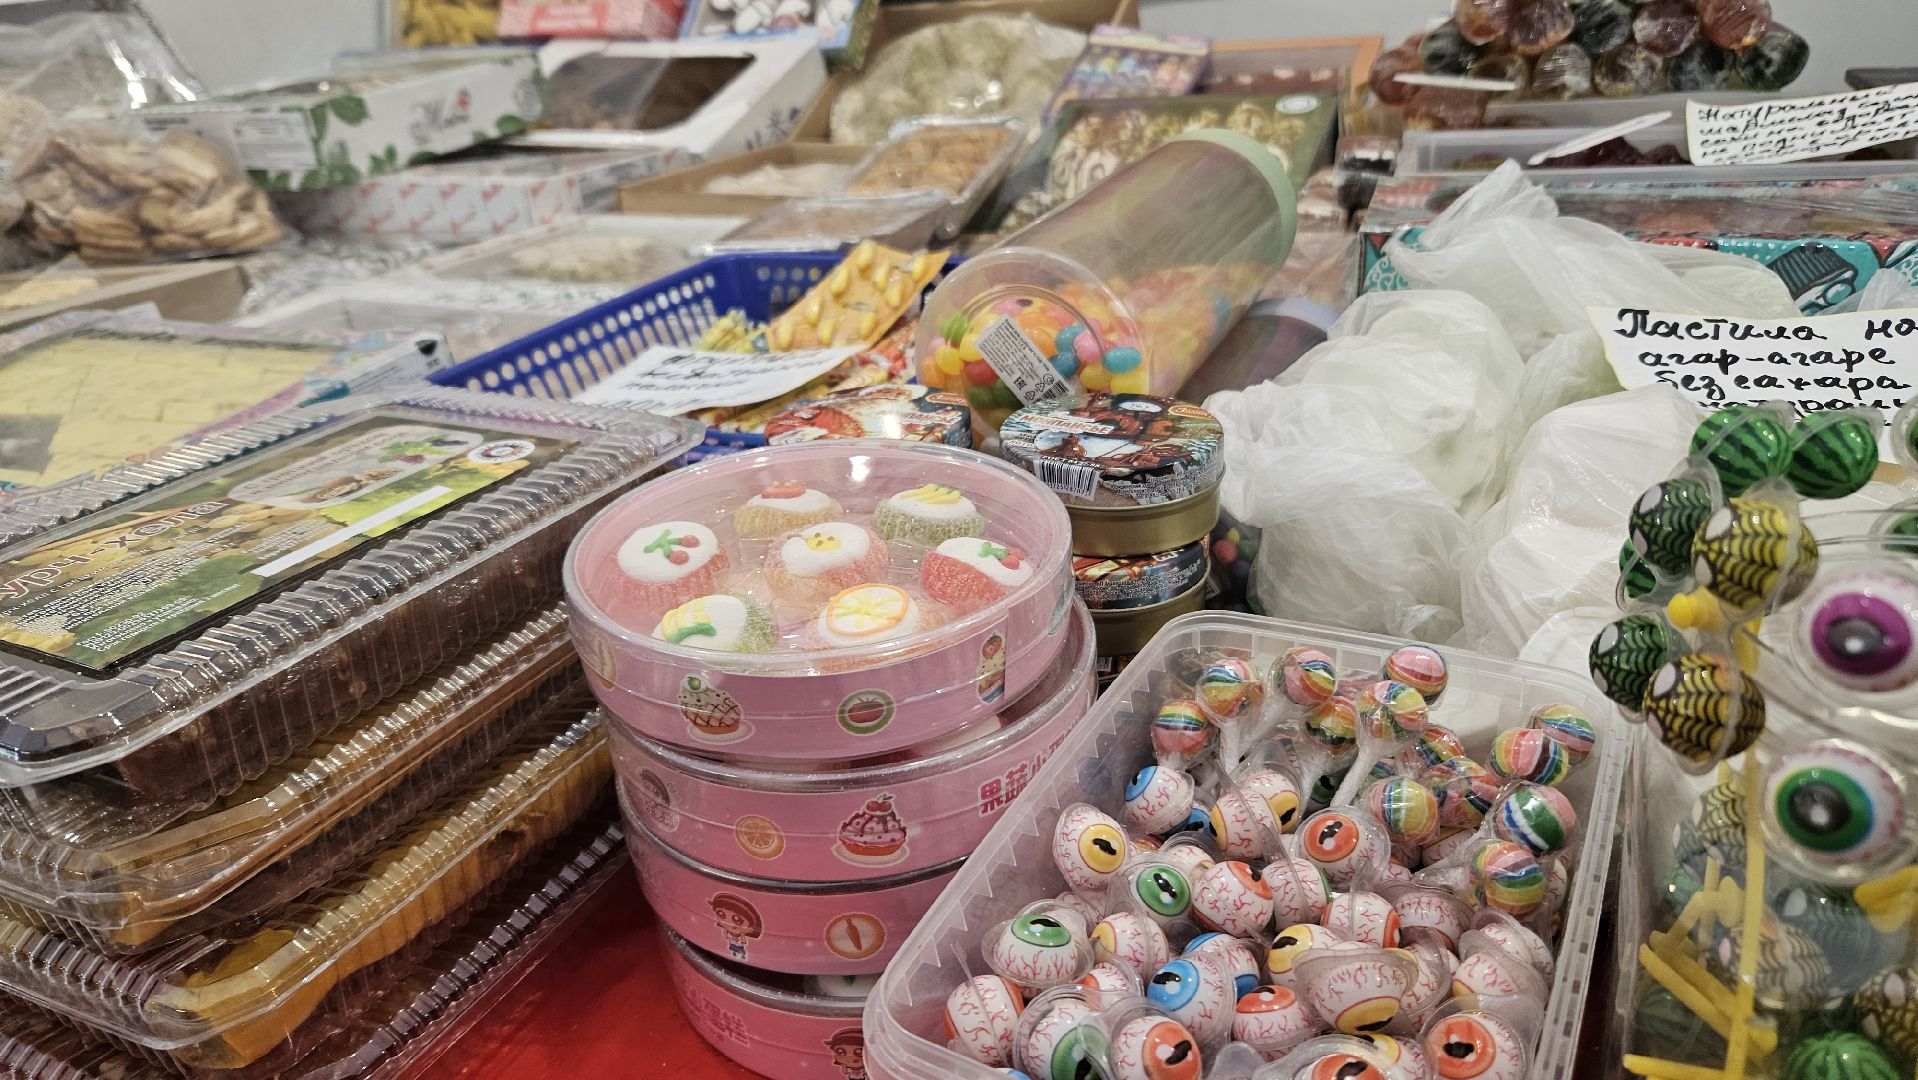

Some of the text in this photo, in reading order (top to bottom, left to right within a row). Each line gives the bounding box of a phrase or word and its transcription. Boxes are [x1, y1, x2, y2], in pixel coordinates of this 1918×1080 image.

[1613, 308, 1918, 341] Пастила на
[1638, 346, 1896, 375] агар-агаре
[1733, 374, 1912, 400] сахара
[1021, 414, 1112, 435] МОНПАНСЬЕ
